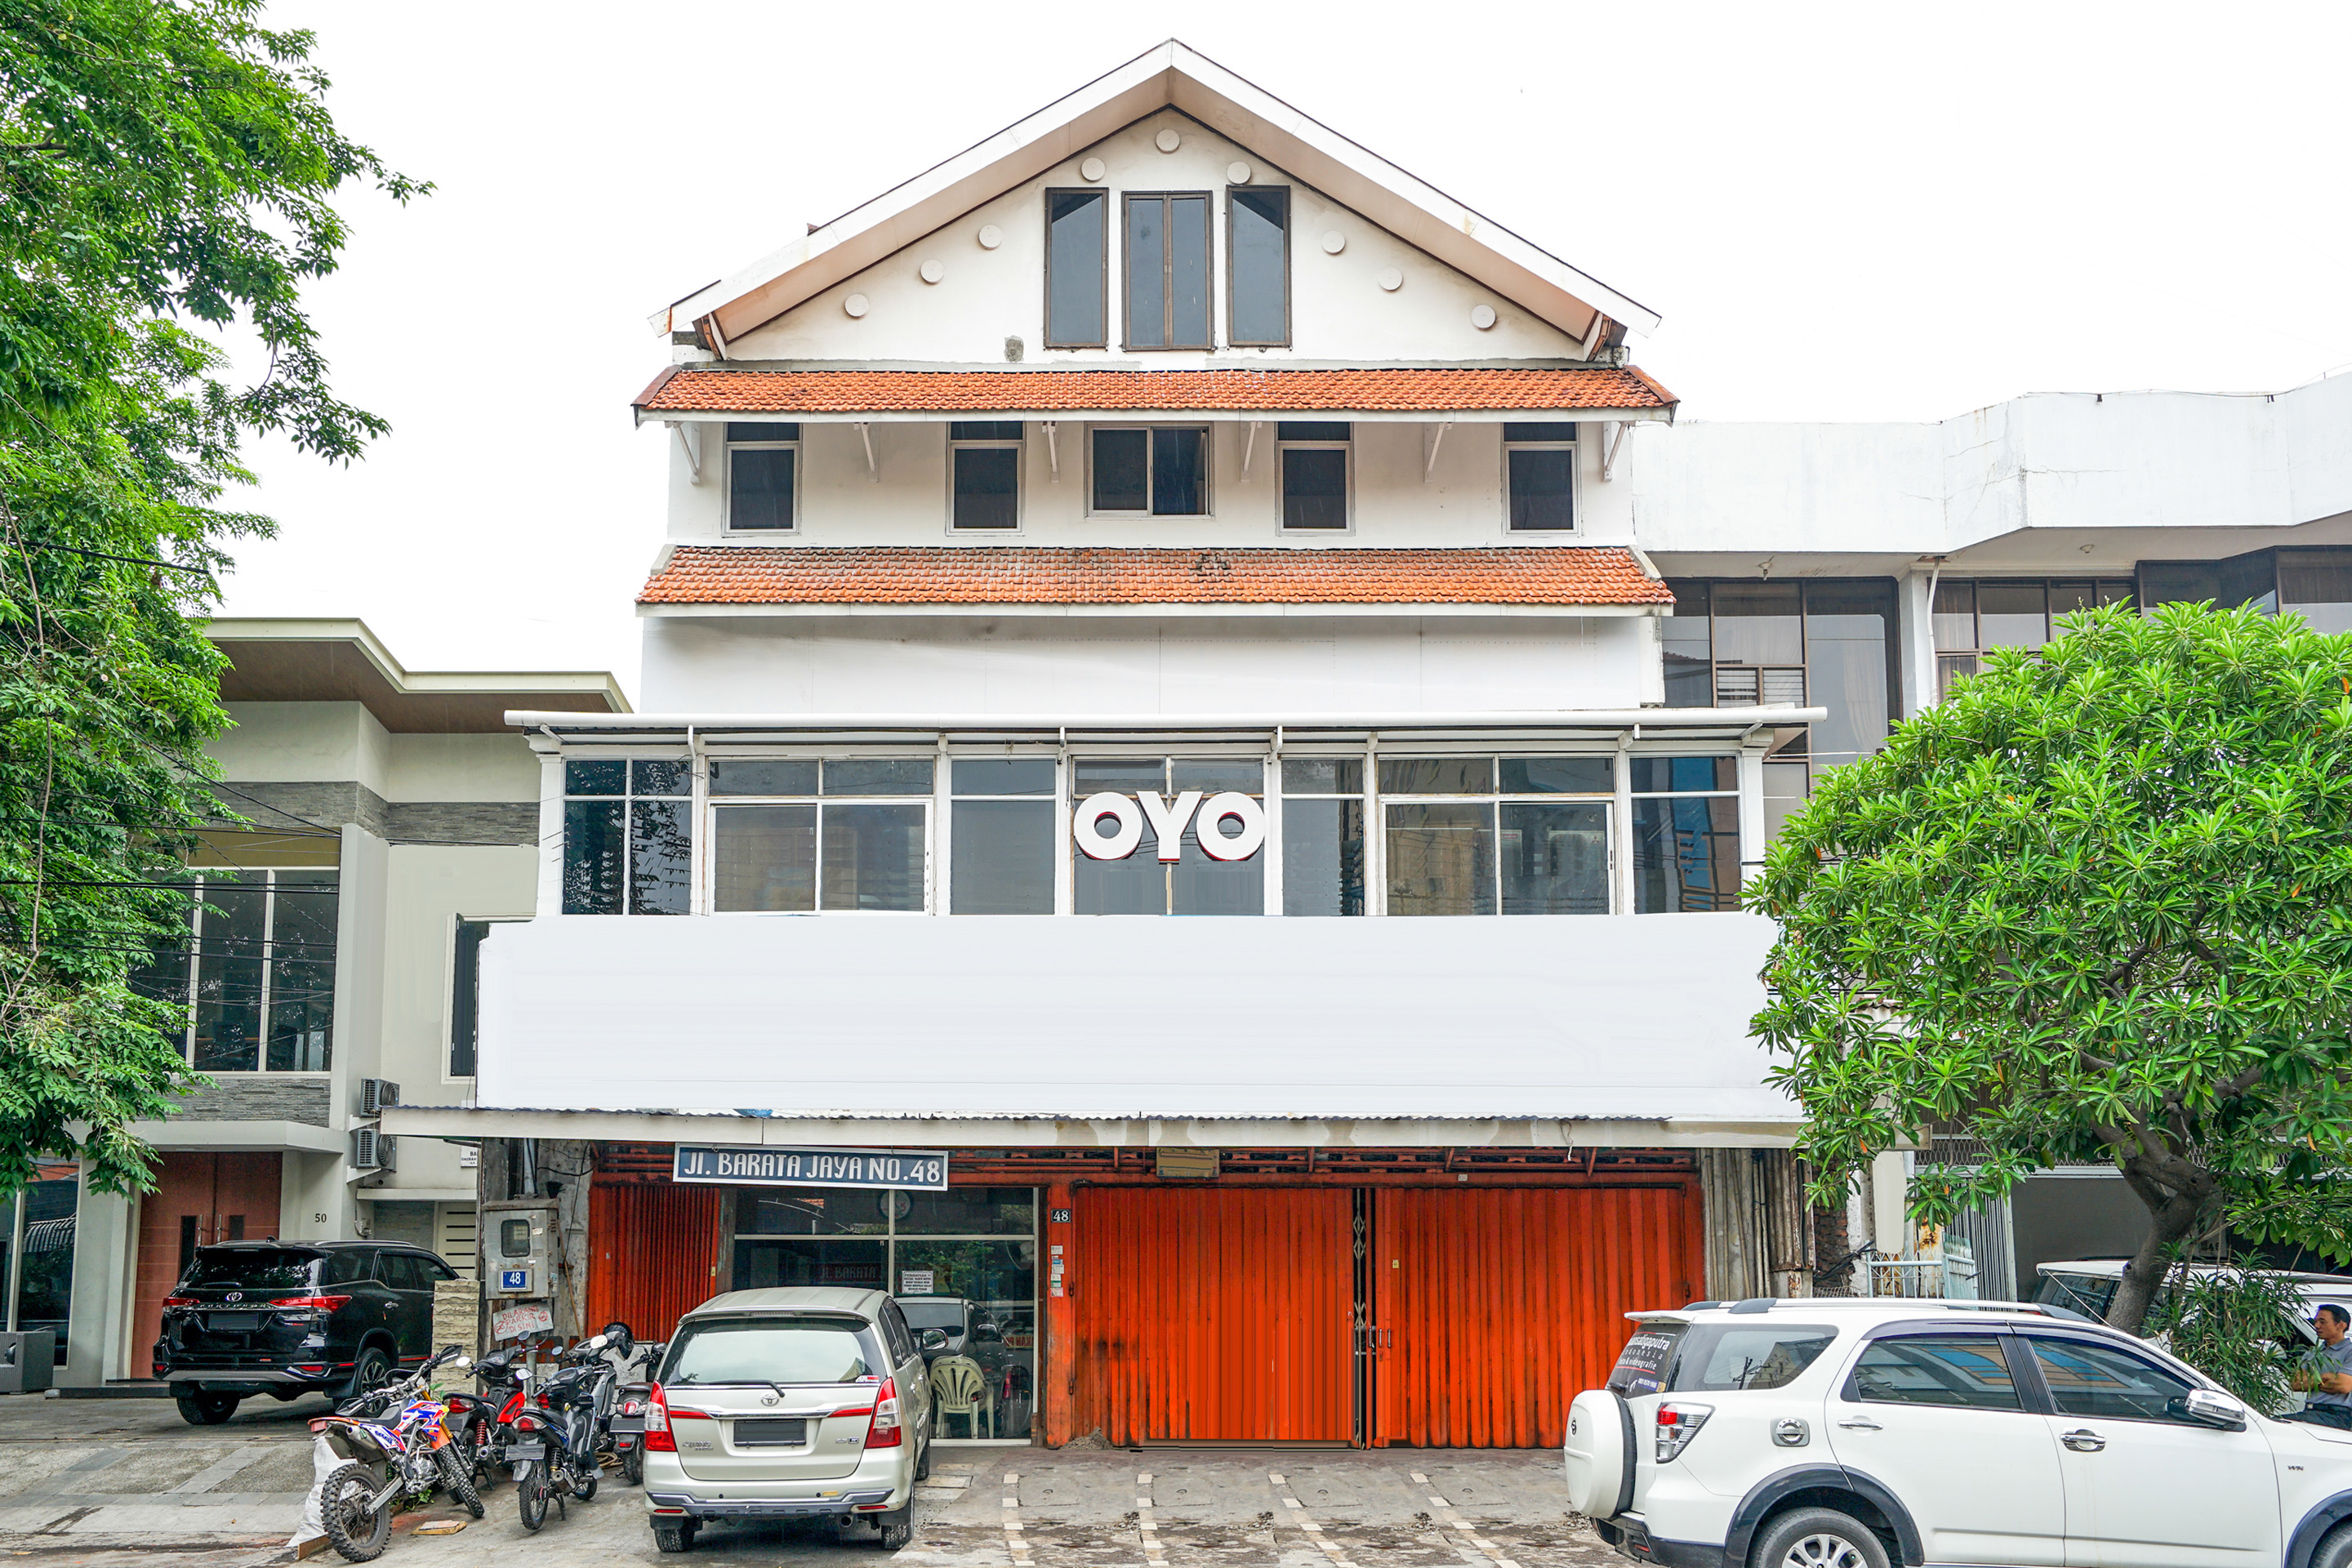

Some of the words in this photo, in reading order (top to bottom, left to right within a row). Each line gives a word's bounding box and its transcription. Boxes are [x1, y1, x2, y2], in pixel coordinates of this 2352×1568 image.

[1073, 791, 1265, 862] OYO
[717, 1152, 800, 1178] BARATA
[805, 1155, 862, 1181] JAYA
[314, 1213, 327, 1223] 50
[1053, 1210, 1069, 1222] 48
[509, 1272, 521, 1285] 48
[501, 1305, 539, 1321] DILARANG
[506, 1312, 536, 1325] PARKIR
